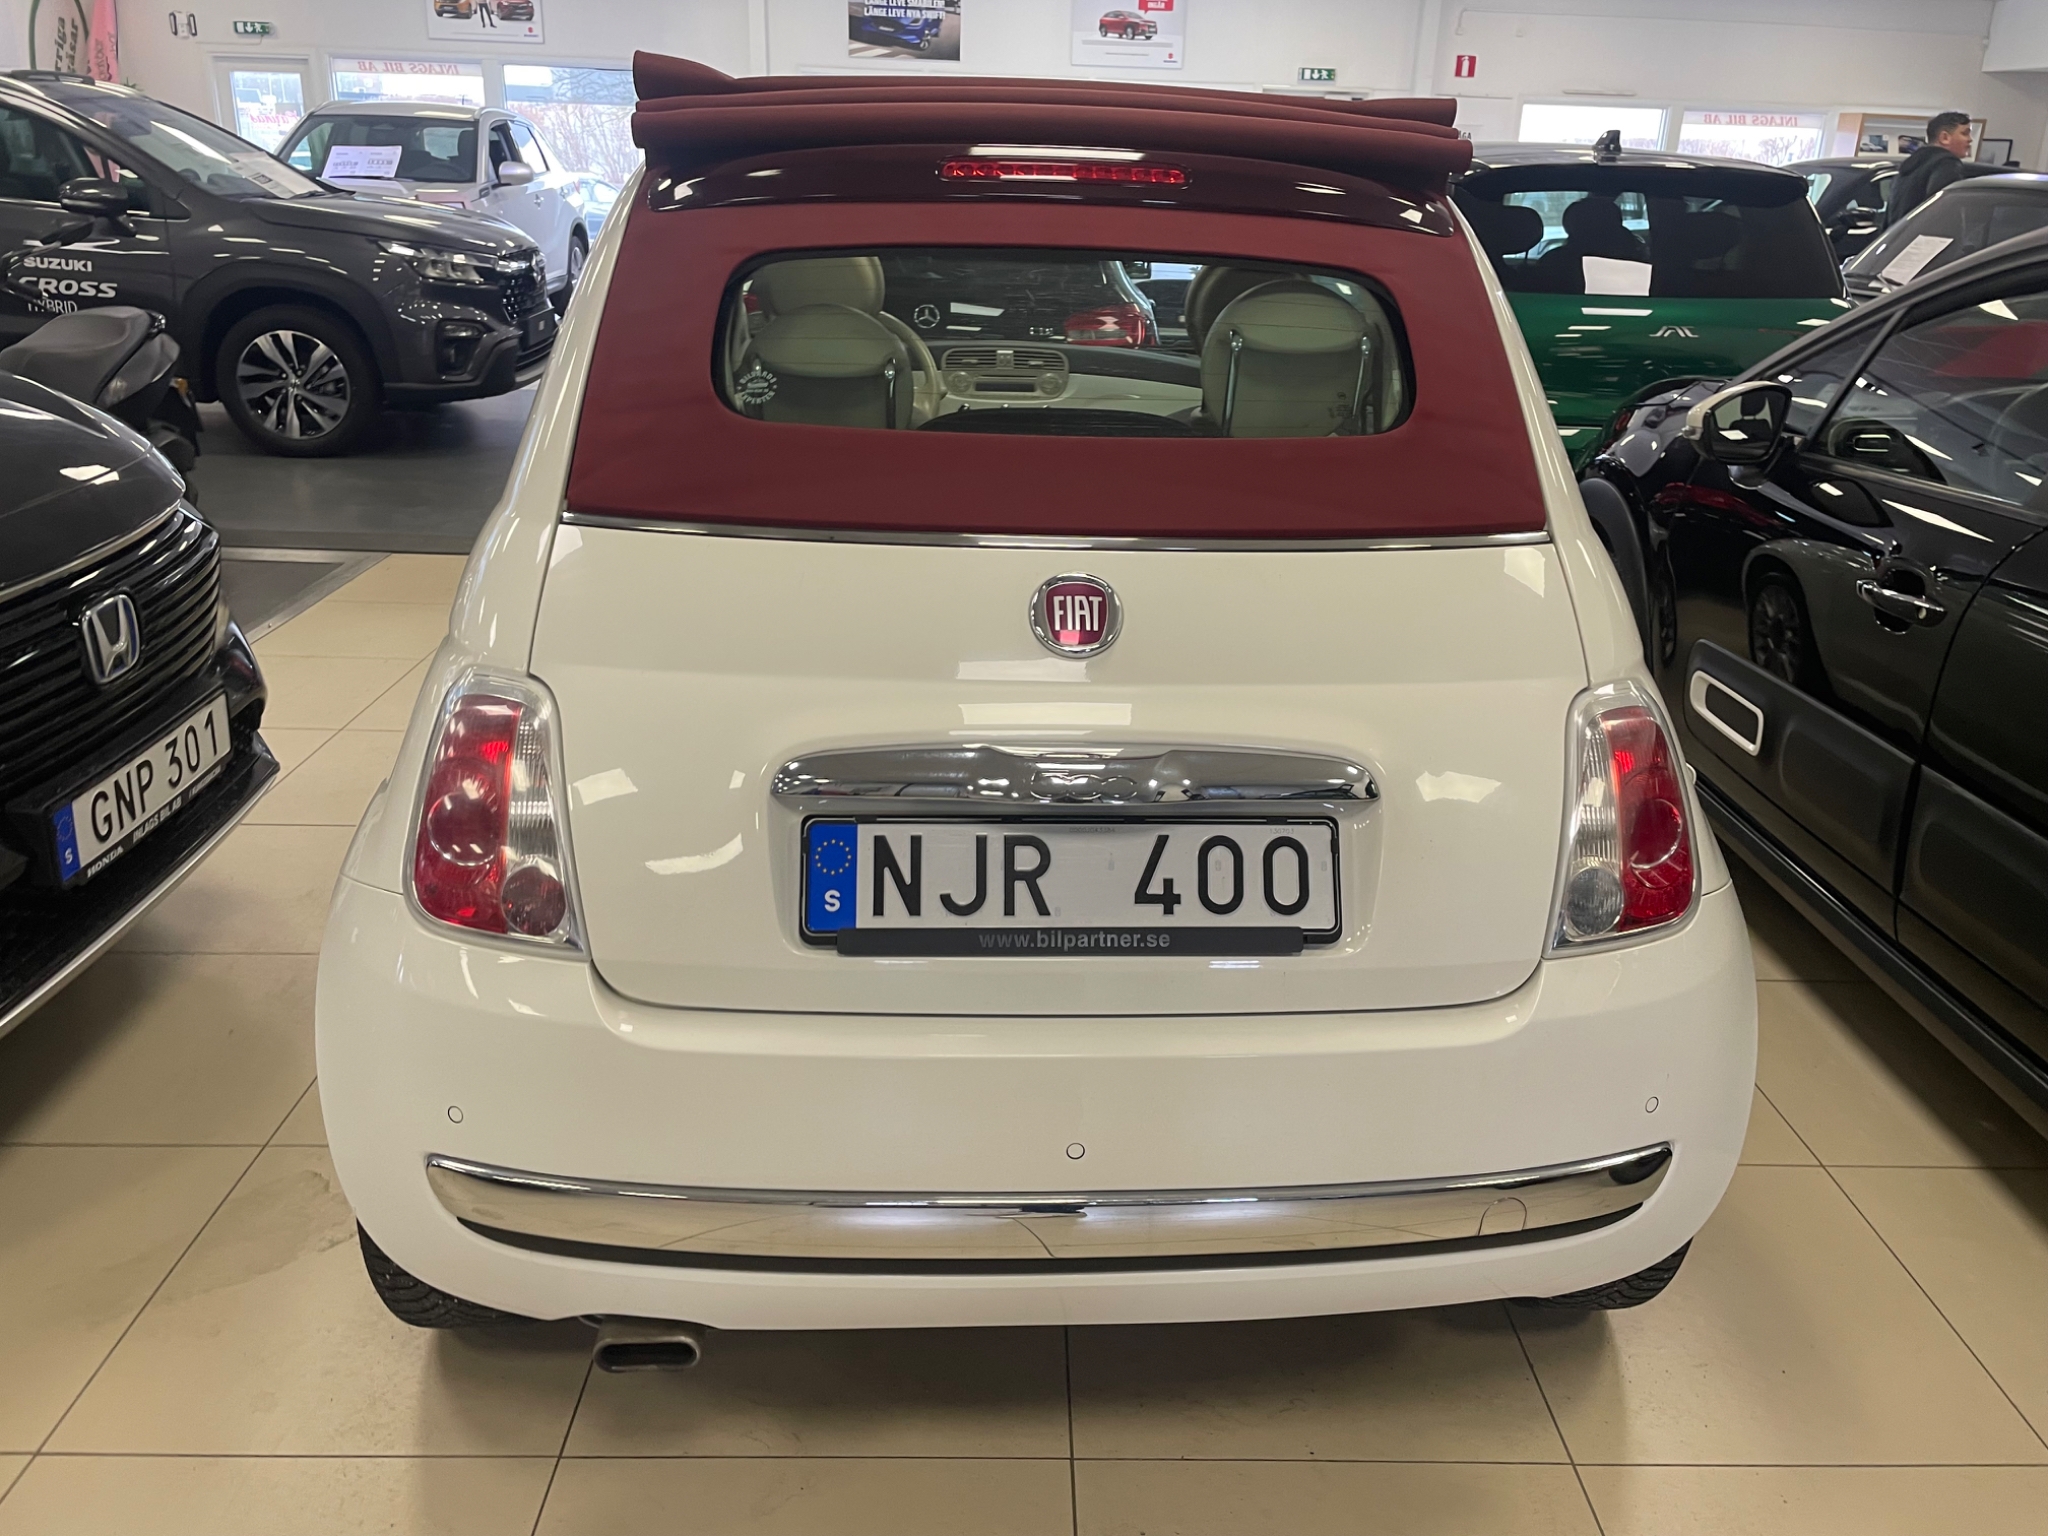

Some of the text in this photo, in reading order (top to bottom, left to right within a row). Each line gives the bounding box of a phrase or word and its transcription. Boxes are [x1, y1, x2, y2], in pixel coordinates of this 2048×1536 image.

[888, 8, 906, 17] LEVE
[23, 256, 93, 272] SUZUKI
[28, 299, 78, 314] YBRID
[1053, 595, 1103, 631] FIAT
[91, 759, 153, 843] GNP
[165, 709, 218, 789] 301
[65, 848, 73, 864] S
[87, 845, 124, 878] HONDA
[872, 835, 1310, 916] NJR 400
[824, 889, 841, 912] S
[979, 930, 1171, 951] www.bilpartner.se
